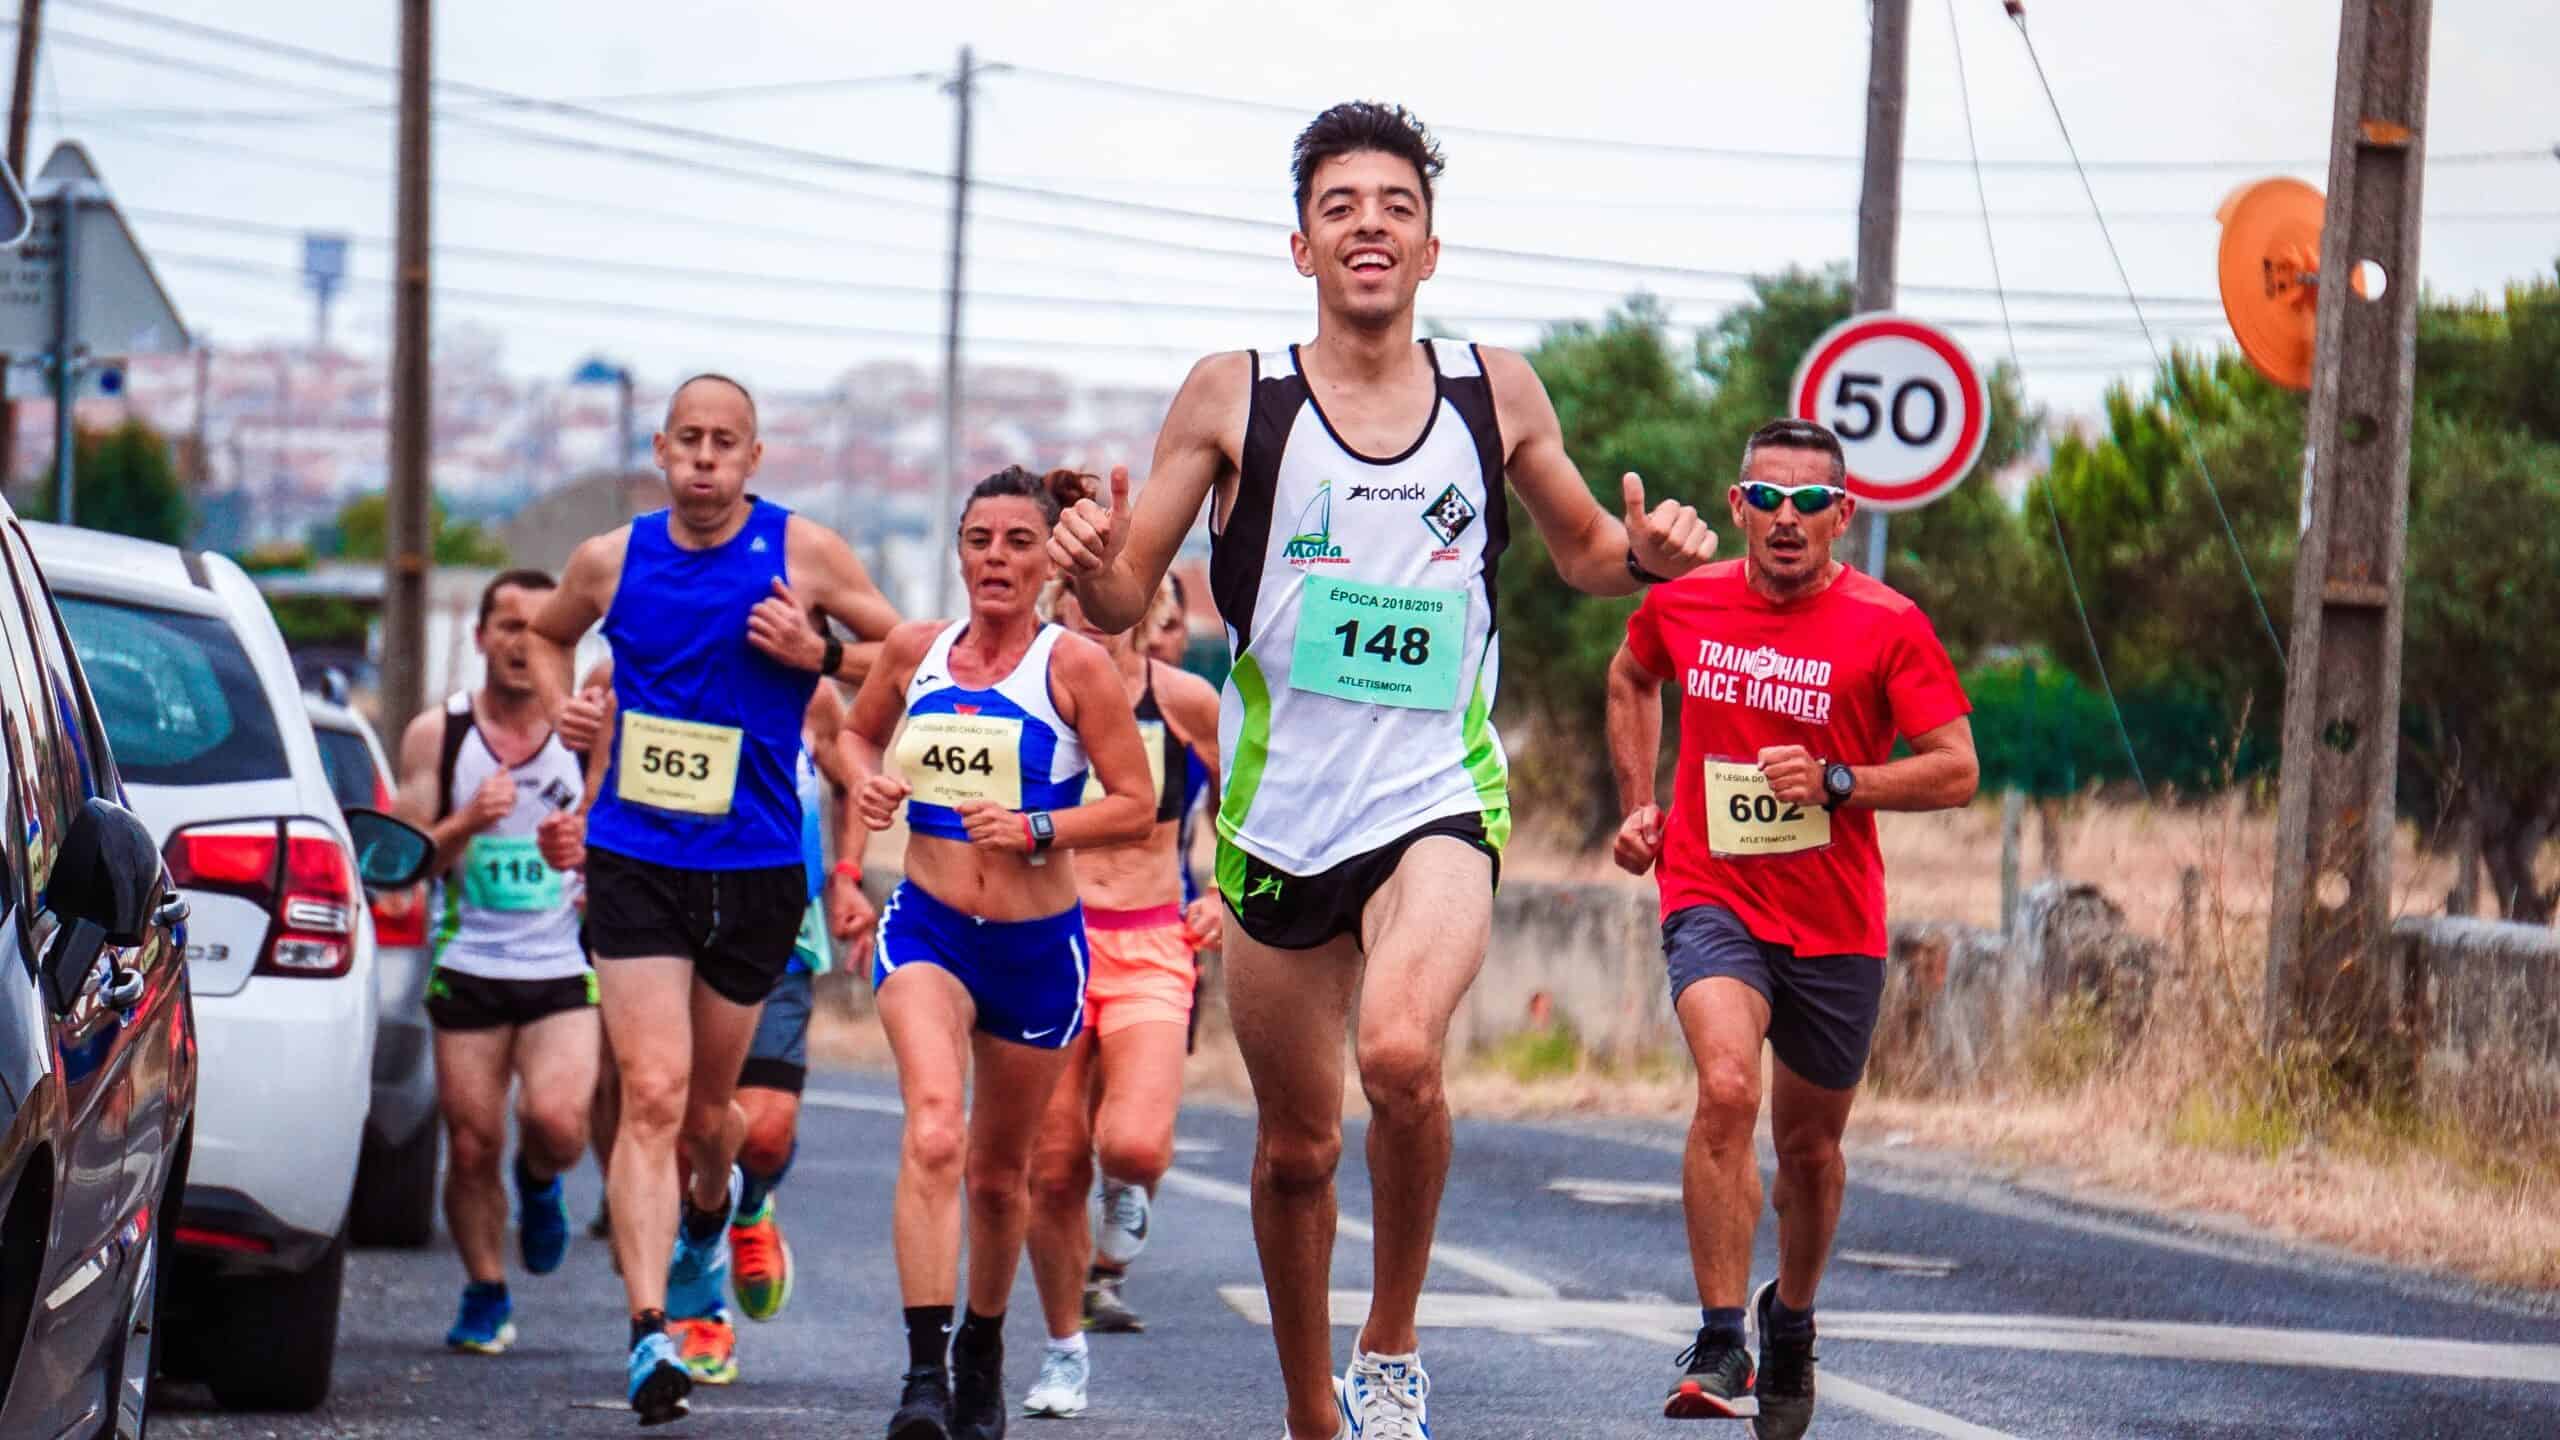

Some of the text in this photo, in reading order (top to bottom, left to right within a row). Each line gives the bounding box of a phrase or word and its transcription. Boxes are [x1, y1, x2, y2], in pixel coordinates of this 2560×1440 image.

[1833, 373, 1947, 446] 50
[1282, 541, 1342, 559] Moita
[1330, 587, 1443, 613] ÉPOCA 2018/2019
[1335, 619, 1431, 666] 148
[1698, 639, 1756, 675] TRAIN
[1776, 655, 1831, 687] HARD
[1338, 675, 1412, 694] ATLETISMOITA
[1687, 668, 1831, 720] RACE HARDER
[642, 745, 710, 781] 563
[921, 744, 994, 777] 464
[1729, 793, 1805, 823] 602
[485, 859, 543, 884] 118
